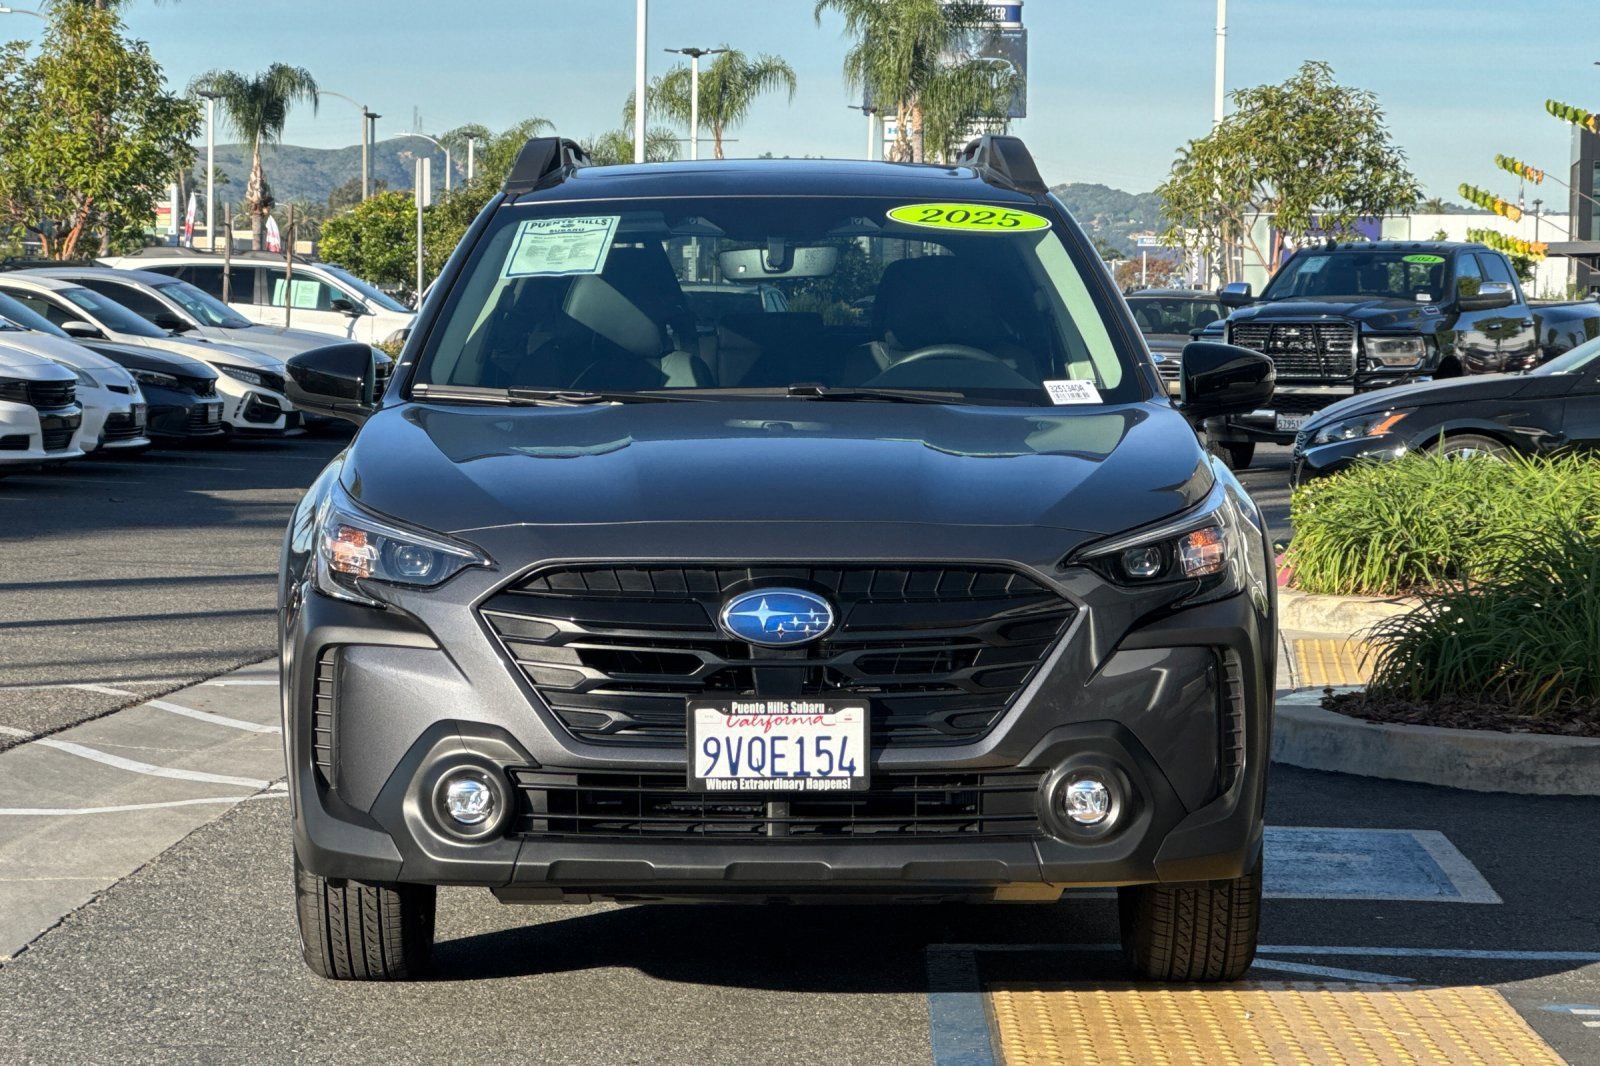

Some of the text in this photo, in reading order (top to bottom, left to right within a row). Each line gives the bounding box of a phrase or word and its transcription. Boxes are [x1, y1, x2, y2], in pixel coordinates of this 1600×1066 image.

[530, 218, 608, 229] PUENTE HILLS
[919, 209, 1022, 227] 2025
[731, 701, 825, 714] Puente Hills Subaru
[726, 714, 836, 733] California
[703, 735, 857, 777] 9VQE154
[706, 778, 851, 791] Where Extraordinary Happens!
